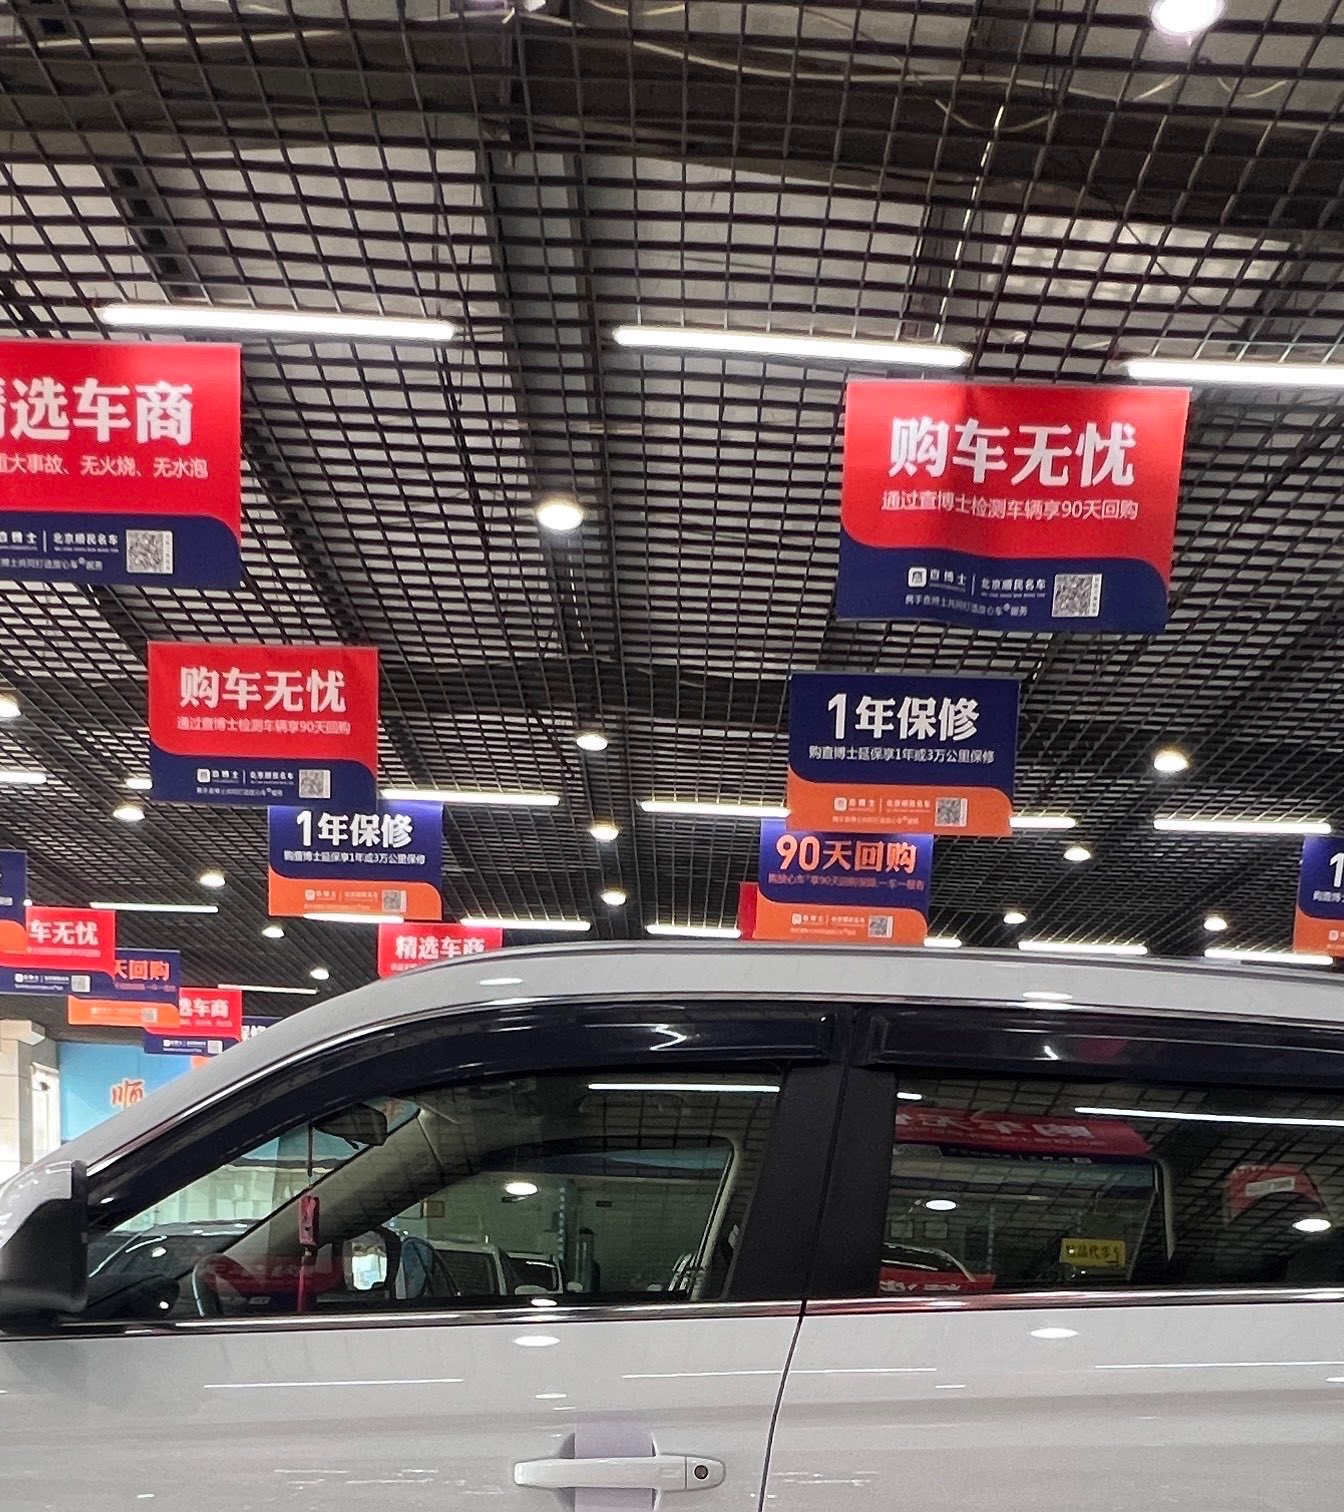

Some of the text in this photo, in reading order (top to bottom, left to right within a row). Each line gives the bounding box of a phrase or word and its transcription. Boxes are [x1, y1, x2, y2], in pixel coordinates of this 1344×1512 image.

[888, 415, 1137, 488] 购车无忧
[178, 665, 347, 713] 购车无忧
[827, 692, 980, 741] 1年保修
[296, 810, 414, 848] 1年保修
[775, 834, 917, 874] 90天回购
[29, 919, 100, 945] 车无忧
[395, 935, 486, 960] 精选车商
